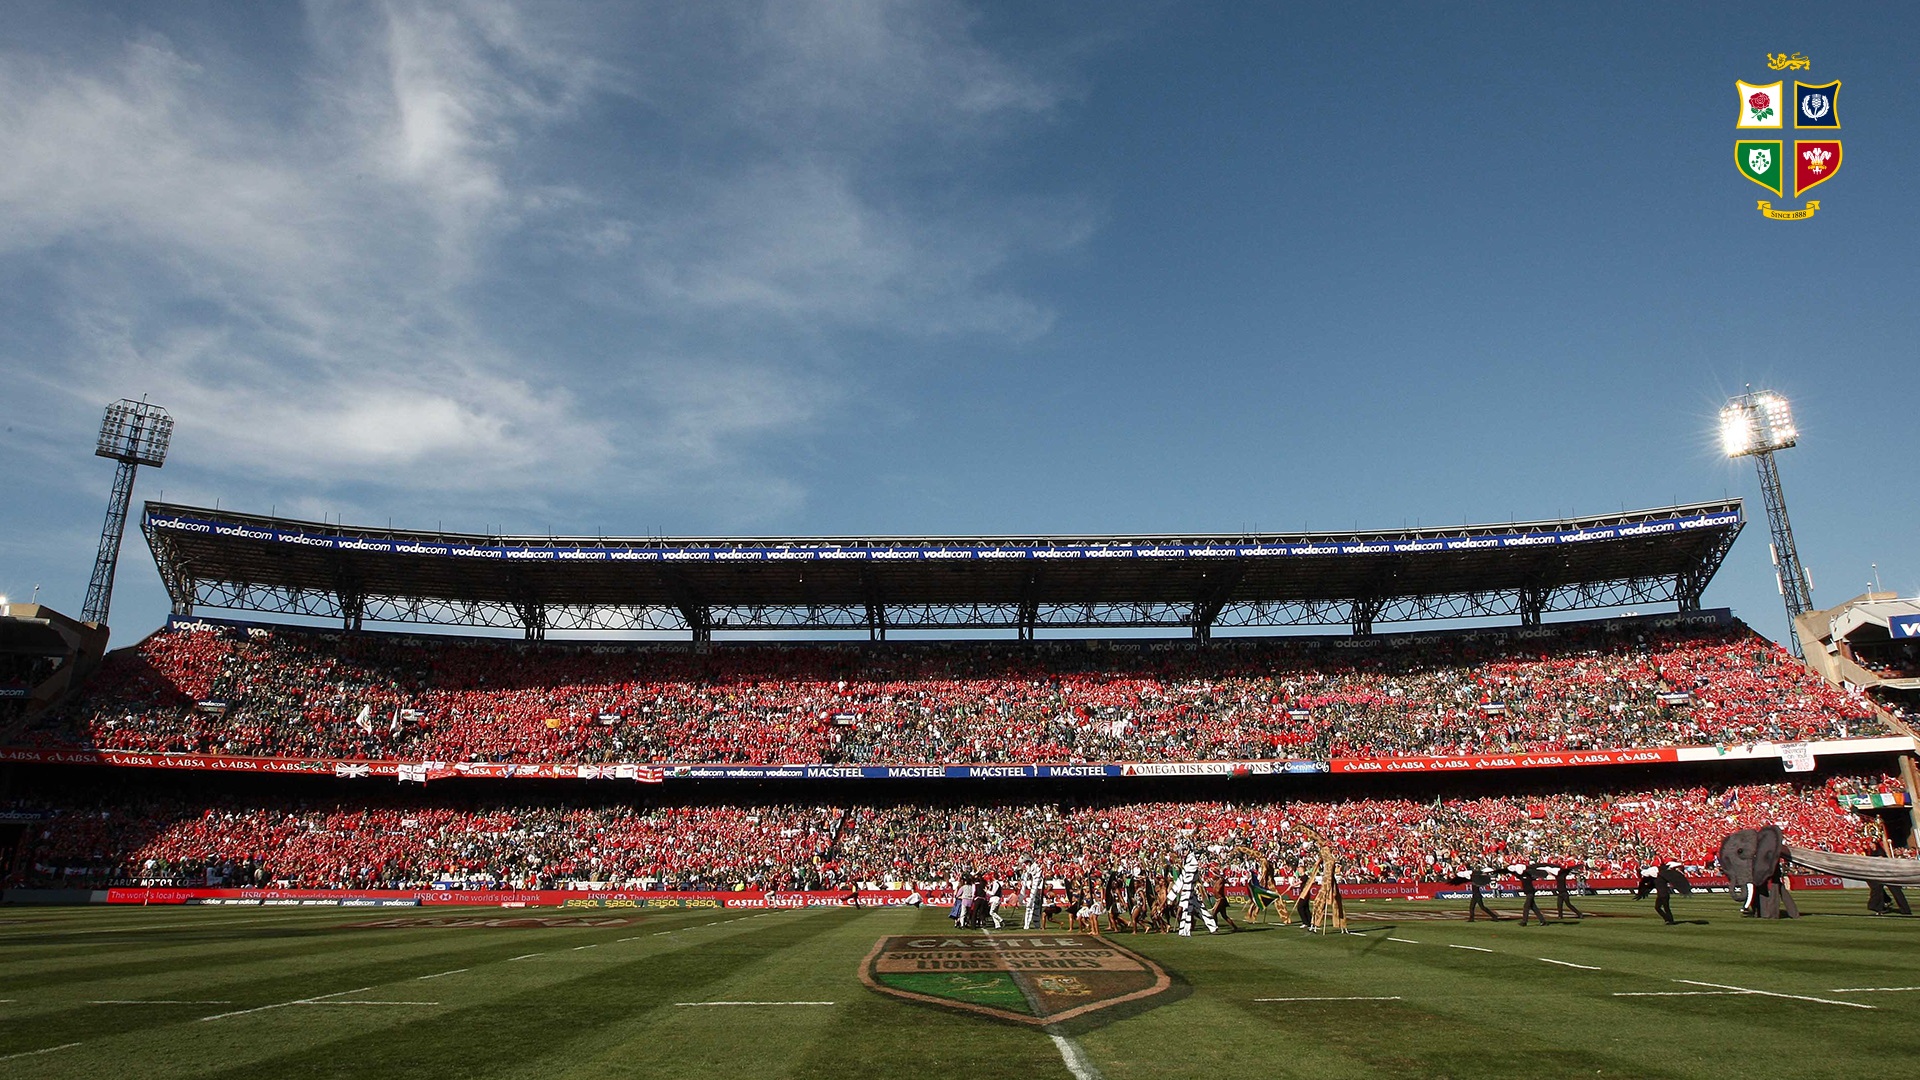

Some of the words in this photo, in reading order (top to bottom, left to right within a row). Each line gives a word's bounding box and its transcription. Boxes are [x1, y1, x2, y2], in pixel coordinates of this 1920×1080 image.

[150, 517, 210, 533] vodacom
[215, 525, 273, 540] vodacom
[277, 532, 333, 548] vodacom
[338, 539, 391, 551] vodacom
[395, 542, 447, 554] vodacom
[451, 547, 502, 558] vodacom
[505, 549, 554, 559] vodacom
[558, 549, 606, 560] vodacom
[610, 550, 658, 560] vodacom
[662, 549, 710, 560] vodacom
[713, 549, 762, 559] vodacom
[766, 549, 814, 559] vodacom
[818, 548, 866, 559] vodacom
[871, 548, 919, 559] vodacom
[923, 548, 972, 559] vodacom
[977, 547, 1026, 559] vodacom
[1032, 547, 1081, 558] vodacom
[1084, 547, 1133, 558] vodacom
[1136, 547, 1184, 558] vodacom
[1188, 546, 1236, 557] vodacom
[1239, 545, 1287, 556] vodacom
[1290, 544, 1338, 555] vodacom
[1342, 543, 1390, 554] vodacom
[1393, 541, 1443, 551] vodacom
[1446, 538, 1498, 549] vodacom
[1503, 535, 1555, 546] vodacom
[1559, 530, 1614, 542] vodacom
[1618, 523, 1675, 536] vodacom
[1679, 515, 1737, 529] vodacom
[9, 752, 41, 760] ABSA
[66, 755, 98, 763] ABSA
[124, 757, 152, 765] ABSA
[175, 759, 206, 767] ABSA
[229, 761, 257, 769] ABSA
[1358, 762, 1382, 770] ABSA
[1401, 761, 1425, 769] ABSA
[1444, 760, 1470, 768] ABSA
[1490, 758, 1516, 766] ABSA
[1537, 756, 1563, 764] ABSA
[1584, 754, 1611, 762] ABSA
[1632, 752, 1661, 760] ABSA
[726, 769, 763, 777] vodacom
[766, 769, 803, 777] vodacom
[807, 767, 864, 777] MACSTEEL
[888, 767, 945, 777] MACSTEEL
[970, 767, 1026, 777] MACSTEEL
[1050, 766, 1107, 776] MACSTEEL
[1136, 764, 1177, 775] OMEGA
[1178, 764, 1204, 774] RISK
[1207, 763, 1270, 774] SOLNS
[1804, 877, 1828, 886] HSBC
[156, 891, 174, 899] local
[1339, 887, 1349, 895] he
[1350, 887, 1379, 895] world's
[1380, 886, 1398, 894] local
[1400, 886, 1418, 894] ban
[455, 893, 469, 901] The
[471, 893, 499, 901] world's
[500, 893, 519, 901] locl
[521, 893, 540, 901] bank
[907, 938, 1083, 948] CASTLE
[917, 960, 997, 969] LIONS
[1008, 958, 1102, 969] SERIES
